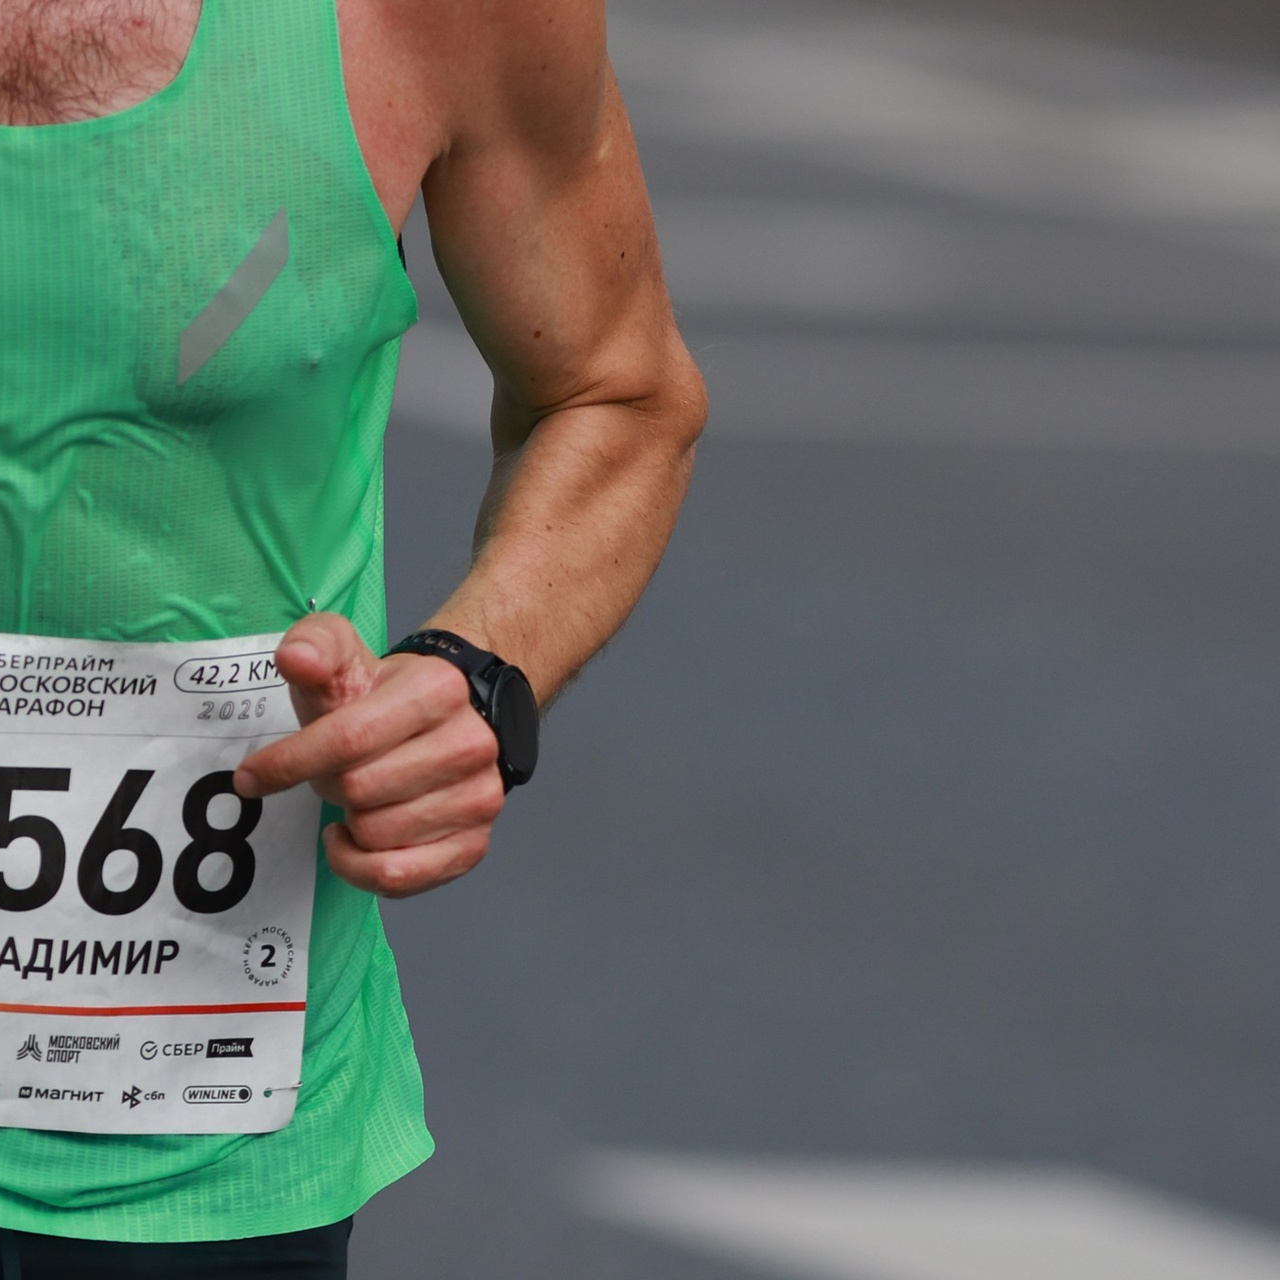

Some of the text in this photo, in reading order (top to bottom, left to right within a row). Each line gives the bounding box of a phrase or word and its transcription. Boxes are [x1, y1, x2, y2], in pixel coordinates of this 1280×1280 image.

[189, 662, 240, 688] 42,2
[261, 944, 276, 968] 2
[48, 1033, 121, 1050] МОСКОВСКИЙ
[46, 1049, 81, 1063] СПОРТ
[162, 1042, 245, 1057] СБЕР Прайм
[34, 1088, 104, 1102] магнит
[144, 1091, 165, 1101] сбп
[187, 1089, 236, 1100] WINLINE
